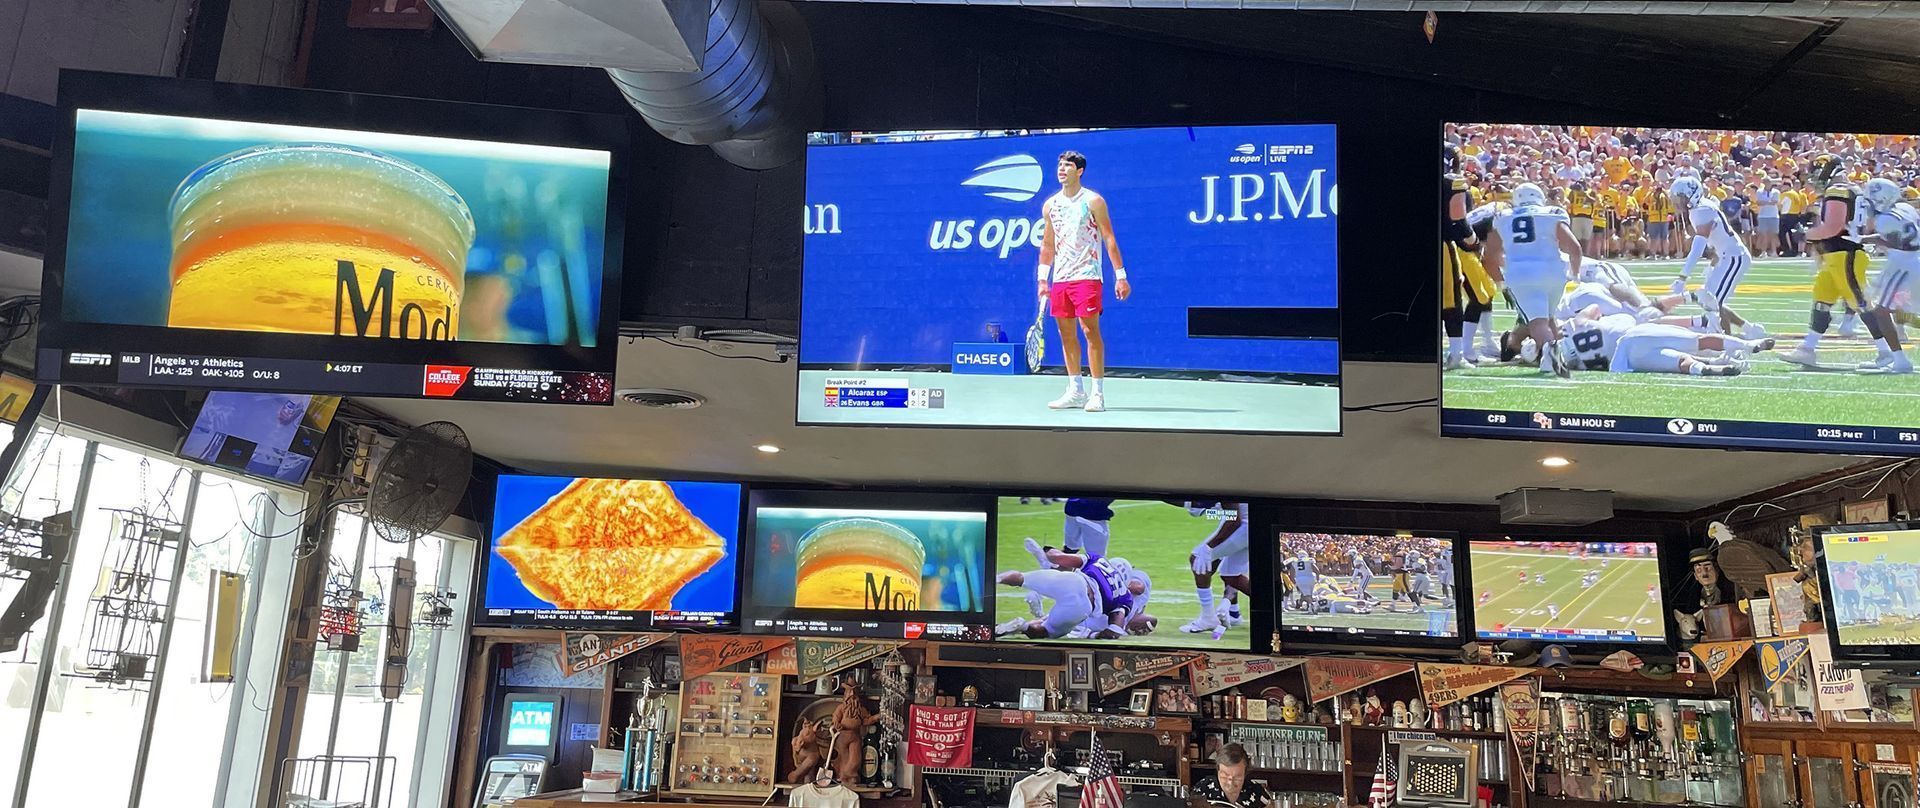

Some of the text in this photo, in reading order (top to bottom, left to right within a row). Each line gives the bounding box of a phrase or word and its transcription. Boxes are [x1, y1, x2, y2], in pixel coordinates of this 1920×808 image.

[1511, 216, 1537, 244] 9
[928, 217, 1046, 259] us ope
[335, 260, 458, 342] Mod
[69, 353, 112, 366] ESPN
[122, 355, 141, 364] MLB
[154, 355, 244, 369] Angels vs Athletics
[956, 353, 998, 365] CHASE
[154, 366, 280, 380] LAA: -125 OAK: +105 O/U: 8
[333, 364, 363, 373] 4:07 ET
[428, 373, 461, 381] COLLEGE
[509, 374, 539, 383] FLORIDA
[540, 375, 562, 384] STATE
[473, 380, 508, 388] SUNDAY
[509, 381, 525, 389] 7:30
[847, 388, 875, 397] Alcaraz
[931, 390, 943, 398] AD
[847, 400, 870, 408] Evans
[1488, 414, 1506, 424] CFB
[1560, 417, 1616, 428] SAM HOU ST
[1698, 423, 1717, 433] BYU
[1817, 428, 1842, 438] 10:15
[1899, 432, 1918, 442] FS1
[865, 572, 919, 612] Mod
[572, 635, 652, 673] GIANTS
[718, 638, 764, 666] Giants
[768, 659, 797, 670] GIAN
[1135, 656, 1173, 669] ALL-TIME
[1443, 667, 1461, 675] 1984
[1428, 689, 1458, 703] 49ERS
[511, 710, 551, 725] ATM
[916, 708, 969, 722] WHO'S GOT IT
[916, 716, 936, 727] BETTER
[915, 729, 966, 743] NOBODY!
[1238, 727, 1321, 742] BUDWEISER GLEN
[520, 762, 542, 773] ATM
